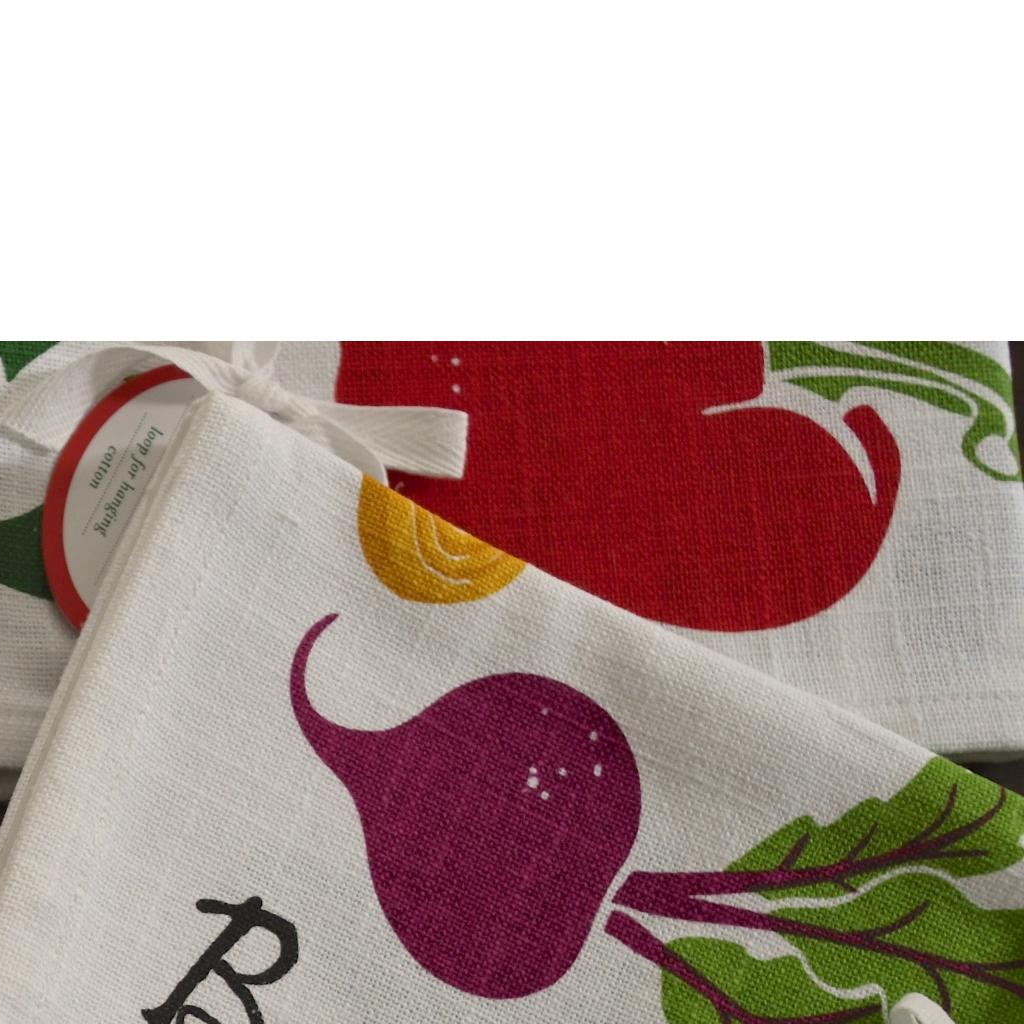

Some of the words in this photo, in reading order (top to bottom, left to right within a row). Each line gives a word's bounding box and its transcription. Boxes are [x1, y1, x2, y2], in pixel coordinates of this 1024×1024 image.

[138, 426, 164, 456] loop
[89, 445, 117, 490] cotton
[128, 454, 147, 481] for
[93, 481, 136, 538] hanging
